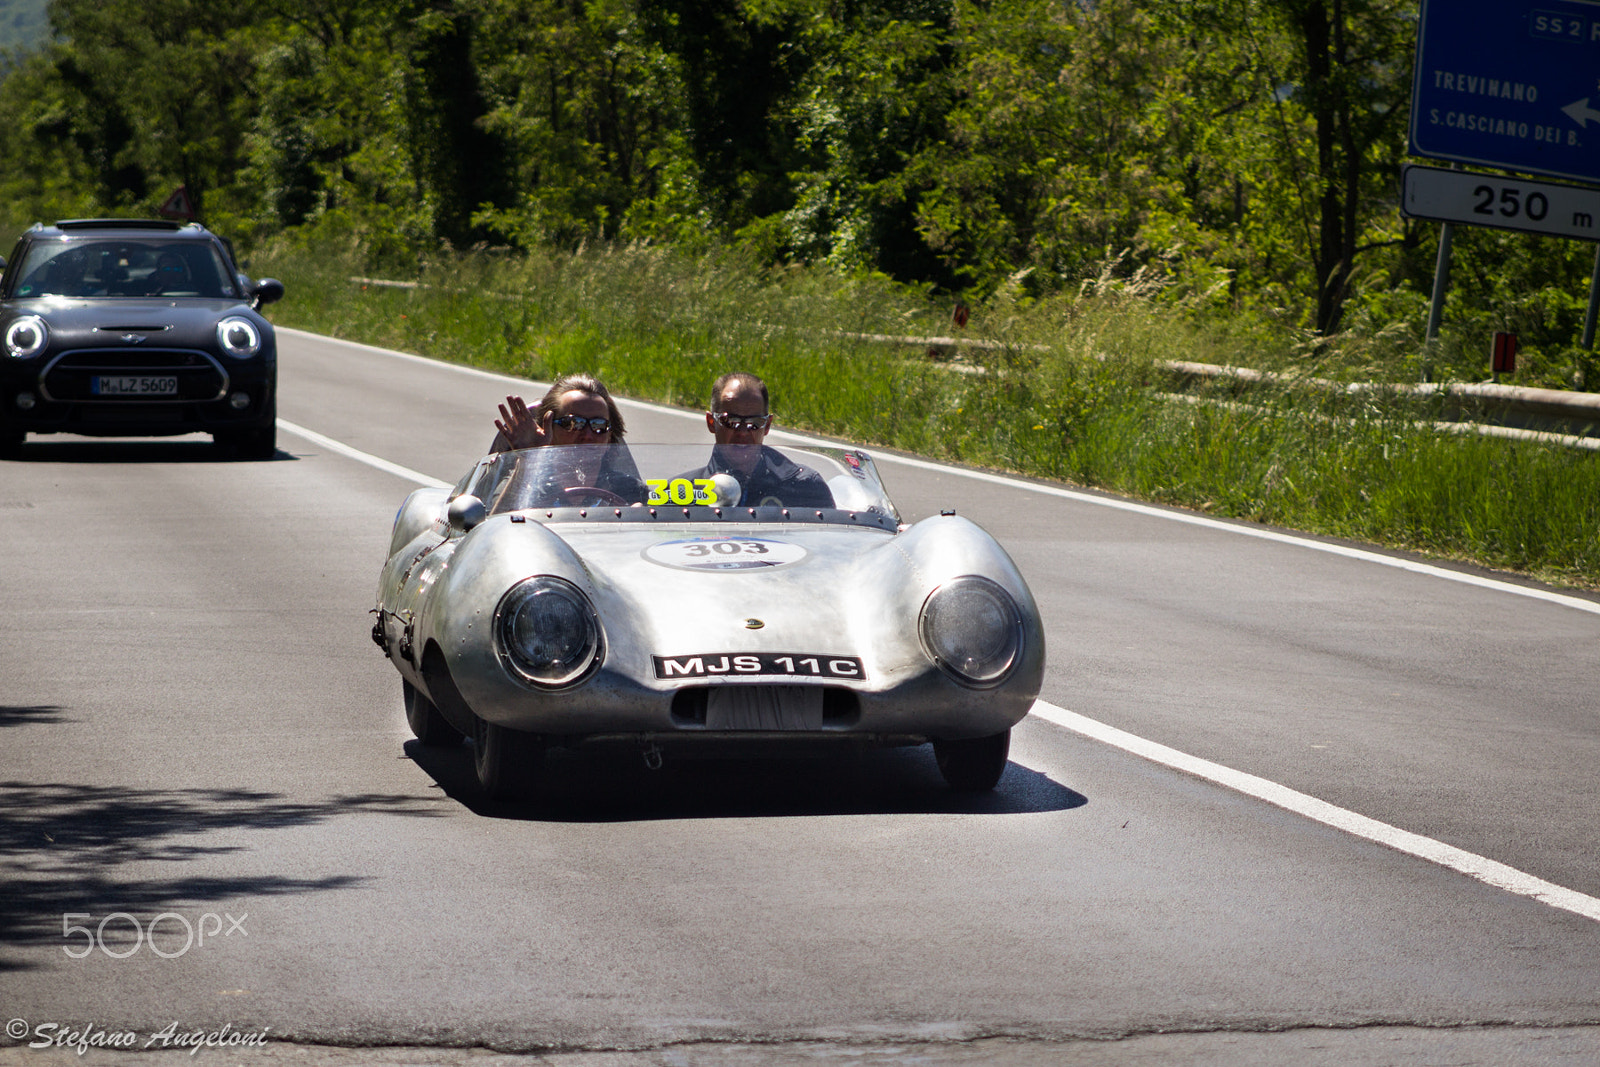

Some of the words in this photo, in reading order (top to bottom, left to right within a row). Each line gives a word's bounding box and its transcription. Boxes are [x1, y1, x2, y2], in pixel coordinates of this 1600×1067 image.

[1535, 16, 1563, 33] SS
[1568, 20, 1581, 36] 2
[1434, 70, 1538, 103] TREVINANO
[1535, 124, 1561, 143] DEI
[1567, 130, 1583, 147] B.
[1473, 185, 1549, 221] 250
[1572, 212, 1593, 228] m
[141, 379, 176, 392] 5609
[646, 478, 718, 506] 303
[683, 542, 770, 557] 303
[663, 656, 762, 675] MJS
[774, 657, 859, 675] 11C
